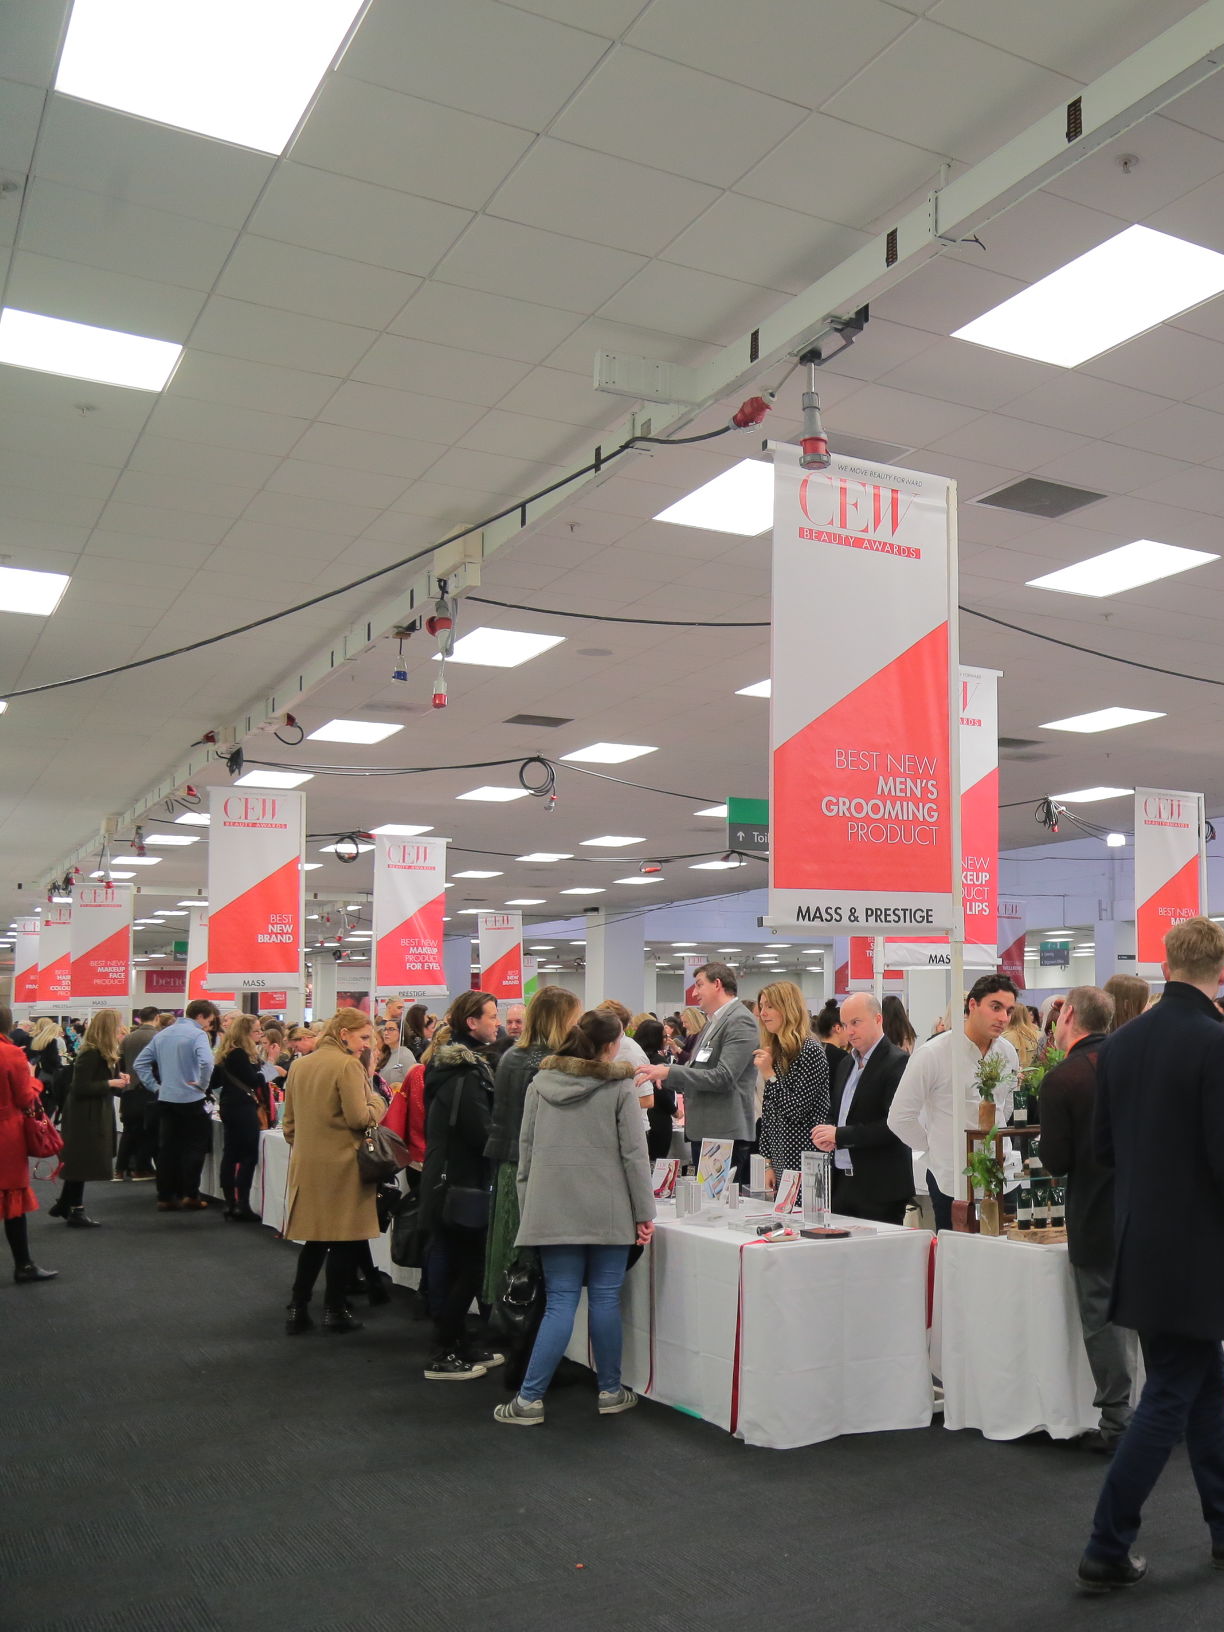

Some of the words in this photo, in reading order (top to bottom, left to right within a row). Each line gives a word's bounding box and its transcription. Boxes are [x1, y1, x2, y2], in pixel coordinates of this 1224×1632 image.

[837, 463, 848, 472] WE
[849, 467, 868, 477] MOVE
[869, 470, 893, 481] BEAUTY
[893, 475, 923, 488] FORWARD
[799, 471, 920, 538] CEW
[803, 528, 856, 546] BEAUTY
[862, 541, 917, 559] AWARDS
[835, 749, 880, 772] BEST
[887, 753, 937, 775] NEW
[876, 776, 939, 800] MEN'S
[223, 796, 285, 820] CEW
[821, 796, 940, 823] GROOMING
[1144, 798, 1183, 820] CEW
[848, 822, 940, 846] PRODUCT
[388, 844, 430, 864] CEW
[796, 906, 843, 923] MASS
[848, 907, 860, 923] &
[865, 907, 934, 924] PRESTIGE
[966, 902, 990, 916] LIPS
[1158, 907, 1175, 917] BEST
[1177, 908, 1196, 918] NEW
[270, 914, 293, 923] BEST
[268, 924, 293, 933] NEW
[257, 934, 293, 943] BRAND
[400, 938, 419, 946] BEST
[421, 939, 438, 947] NEW
[405, 954, 439, 963] PRODUCT
[409, 947, 439, 955] MAKEUP
[406, 962, 422, 971] FOR
[424, 963, 441, 971] EYES
[242, 979, 266, 988] MASS
